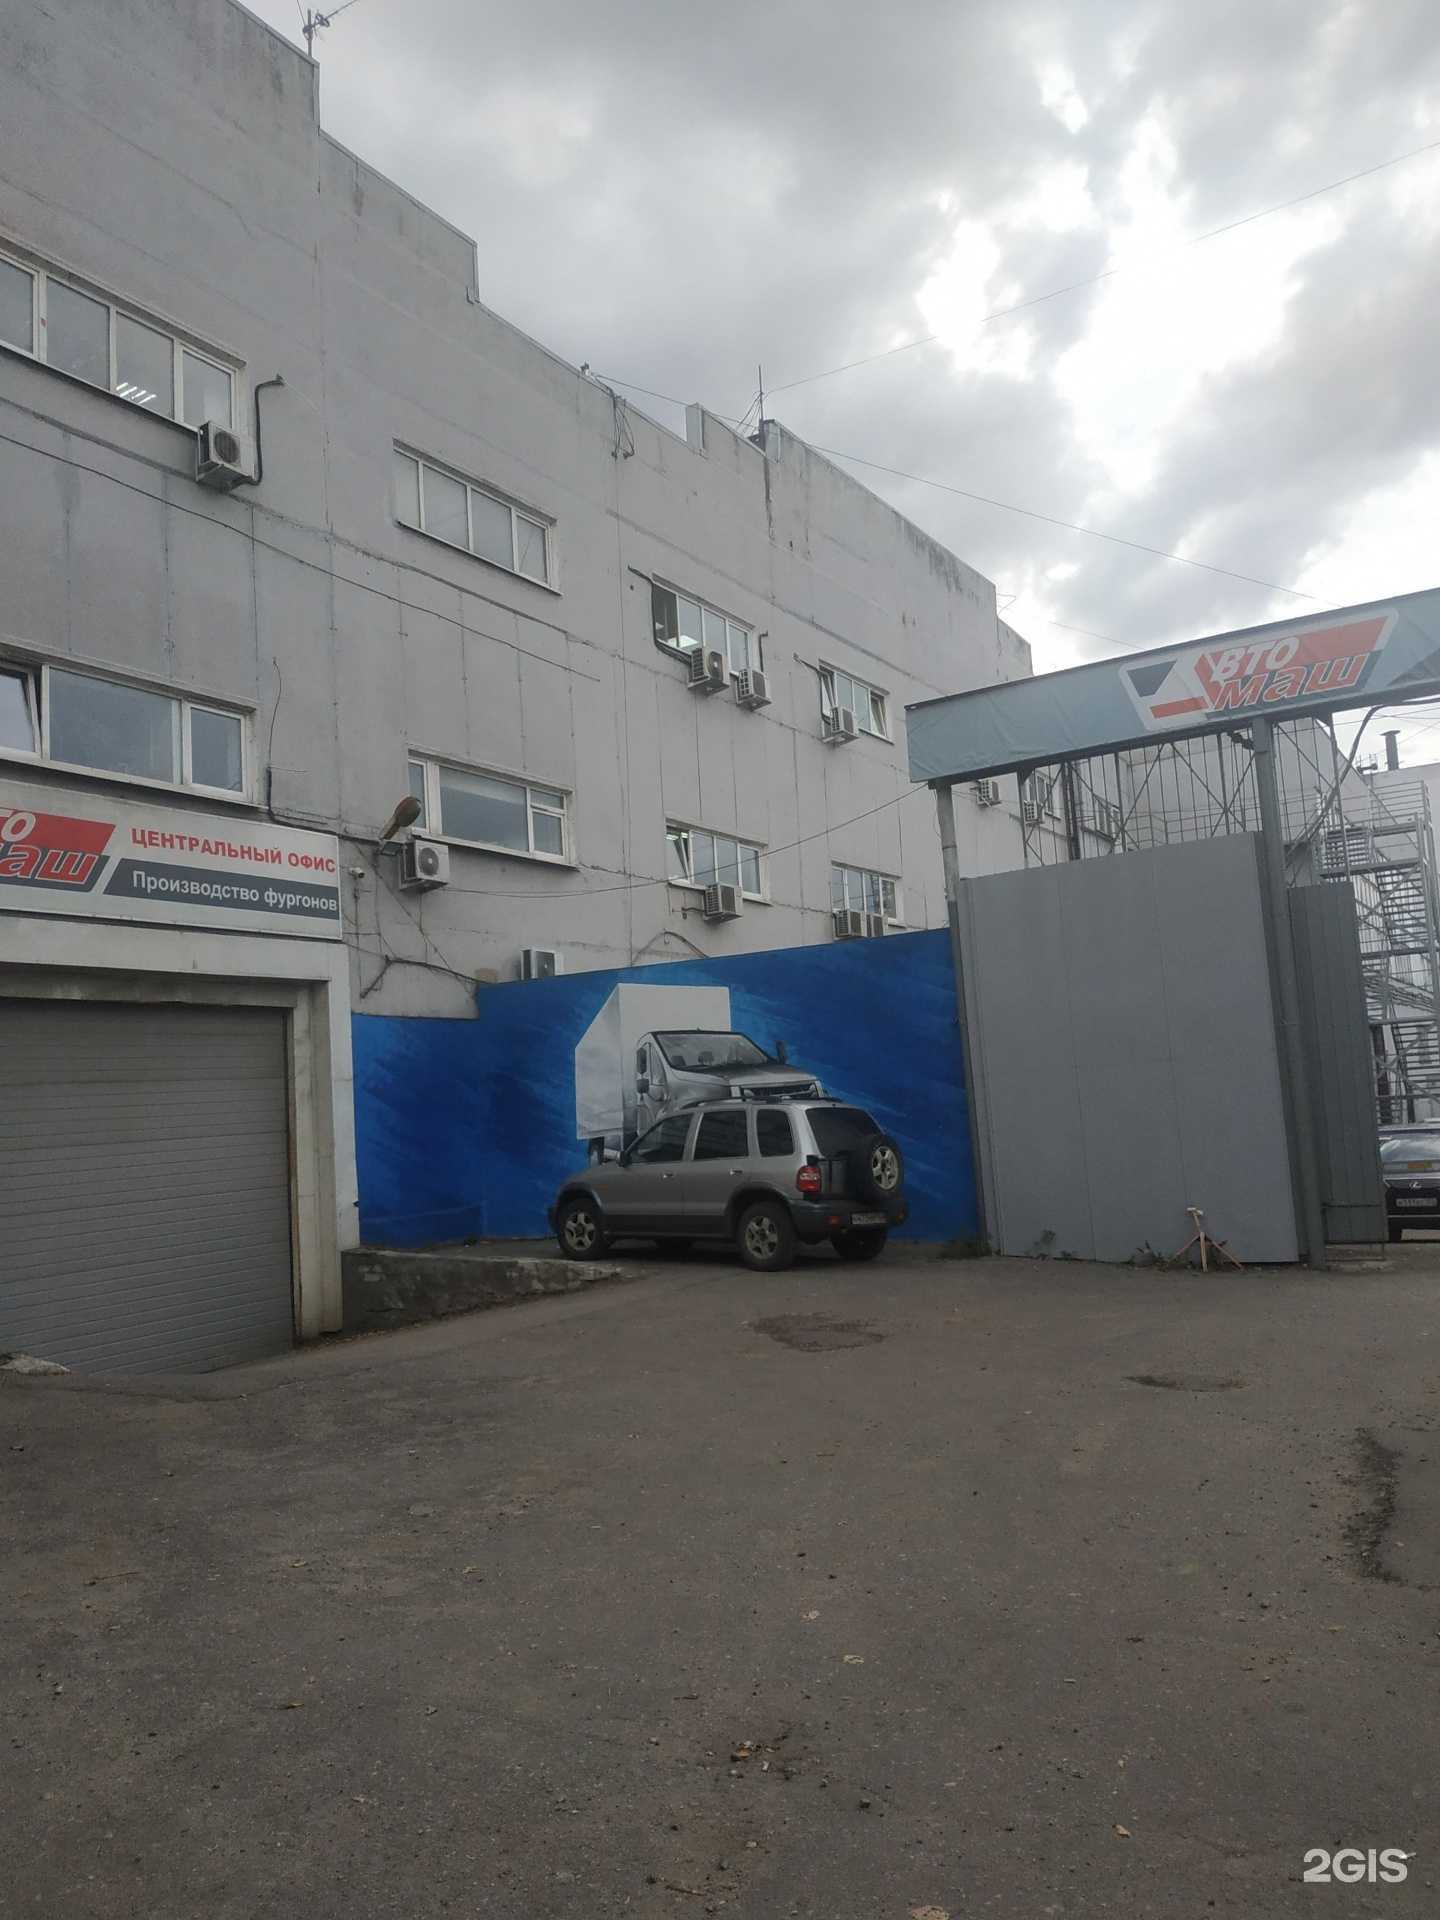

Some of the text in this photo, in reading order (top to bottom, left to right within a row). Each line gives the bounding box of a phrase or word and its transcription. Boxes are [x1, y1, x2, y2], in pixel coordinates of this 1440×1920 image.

[0, 843, 99, 885] аш
[131, 828, 336, 873] ЦЕНТРАЛЬНЫЙ ОФИС
[132, 870, 337, 912] Производство фургонов
